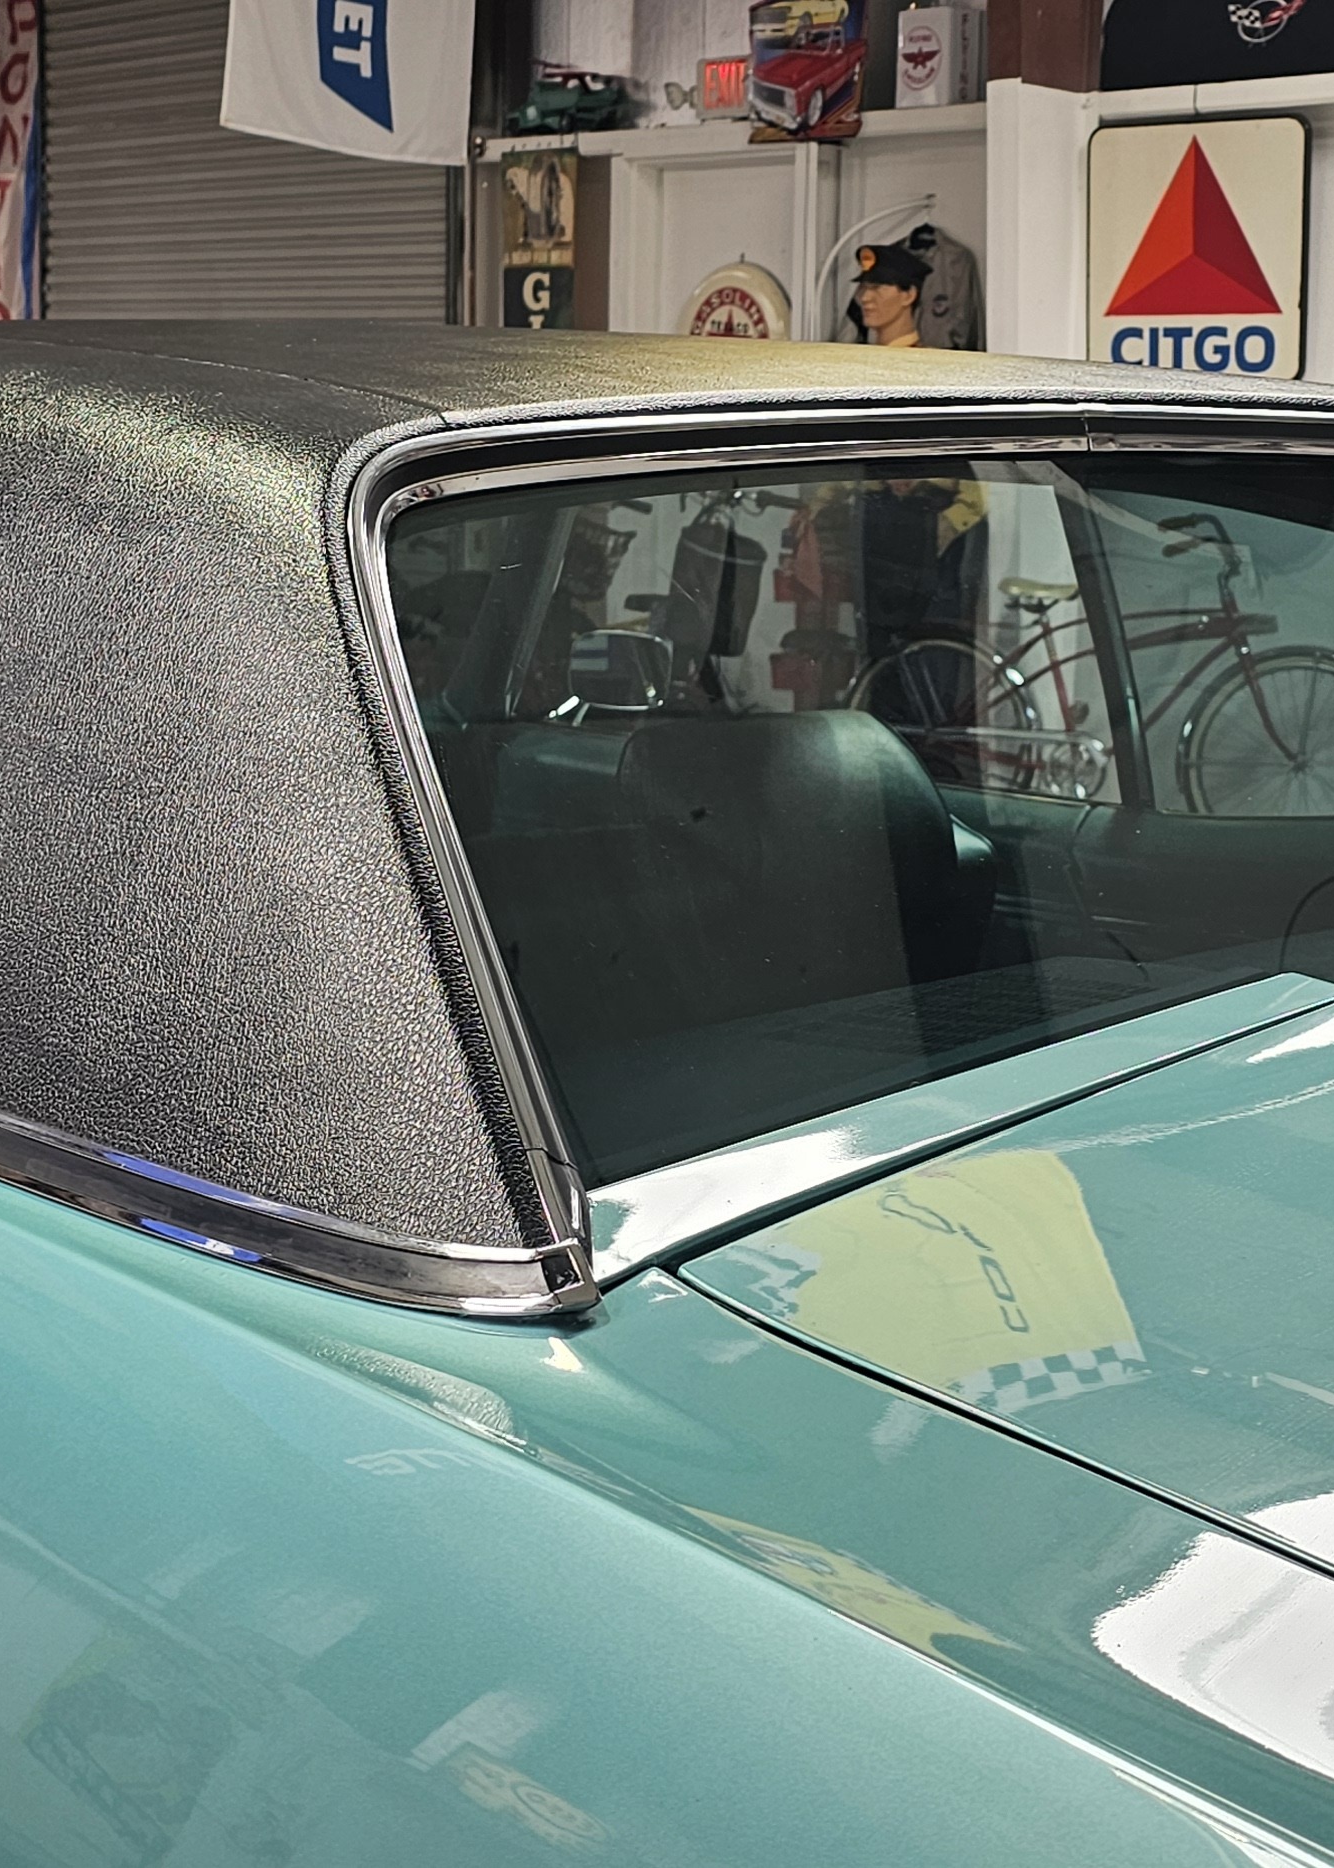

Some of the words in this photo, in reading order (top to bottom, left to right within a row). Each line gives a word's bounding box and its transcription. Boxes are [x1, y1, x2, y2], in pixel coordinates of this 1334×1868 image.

[333, 0, 374, 78] ET
[704, 61, 748, 110] EXIT
[1111, 325, 1275, 373] CITGO
